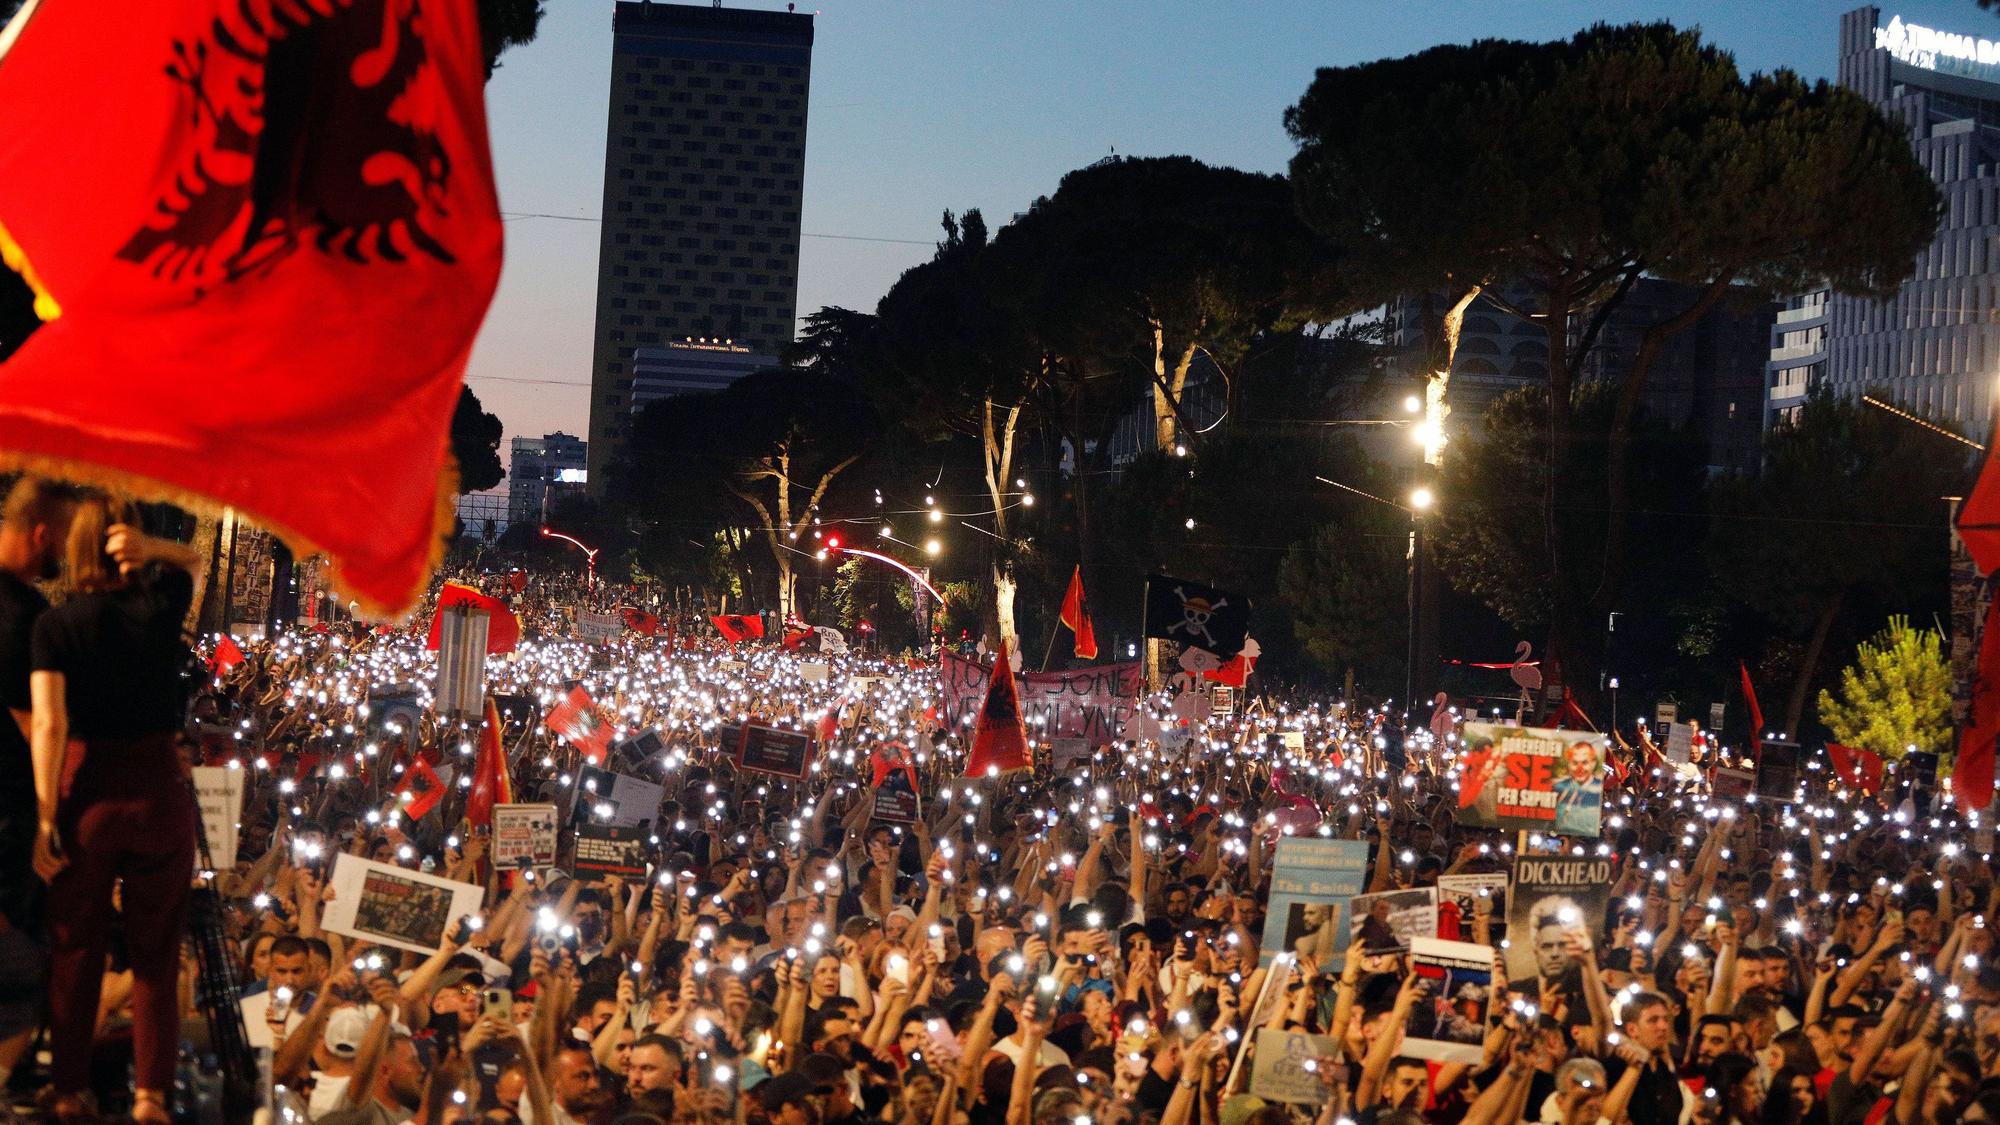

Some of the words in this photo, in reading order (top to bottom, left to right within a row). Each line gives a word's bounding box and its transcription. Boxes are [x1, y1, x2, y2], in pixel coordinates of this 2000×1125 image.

[1504, 753, 1554, 792] SE
[1519, 861, 1610, 885] DICKHEAD
[1276, 879, 1304, 893] The
[1310, 881, 1358, 895] Smiths
